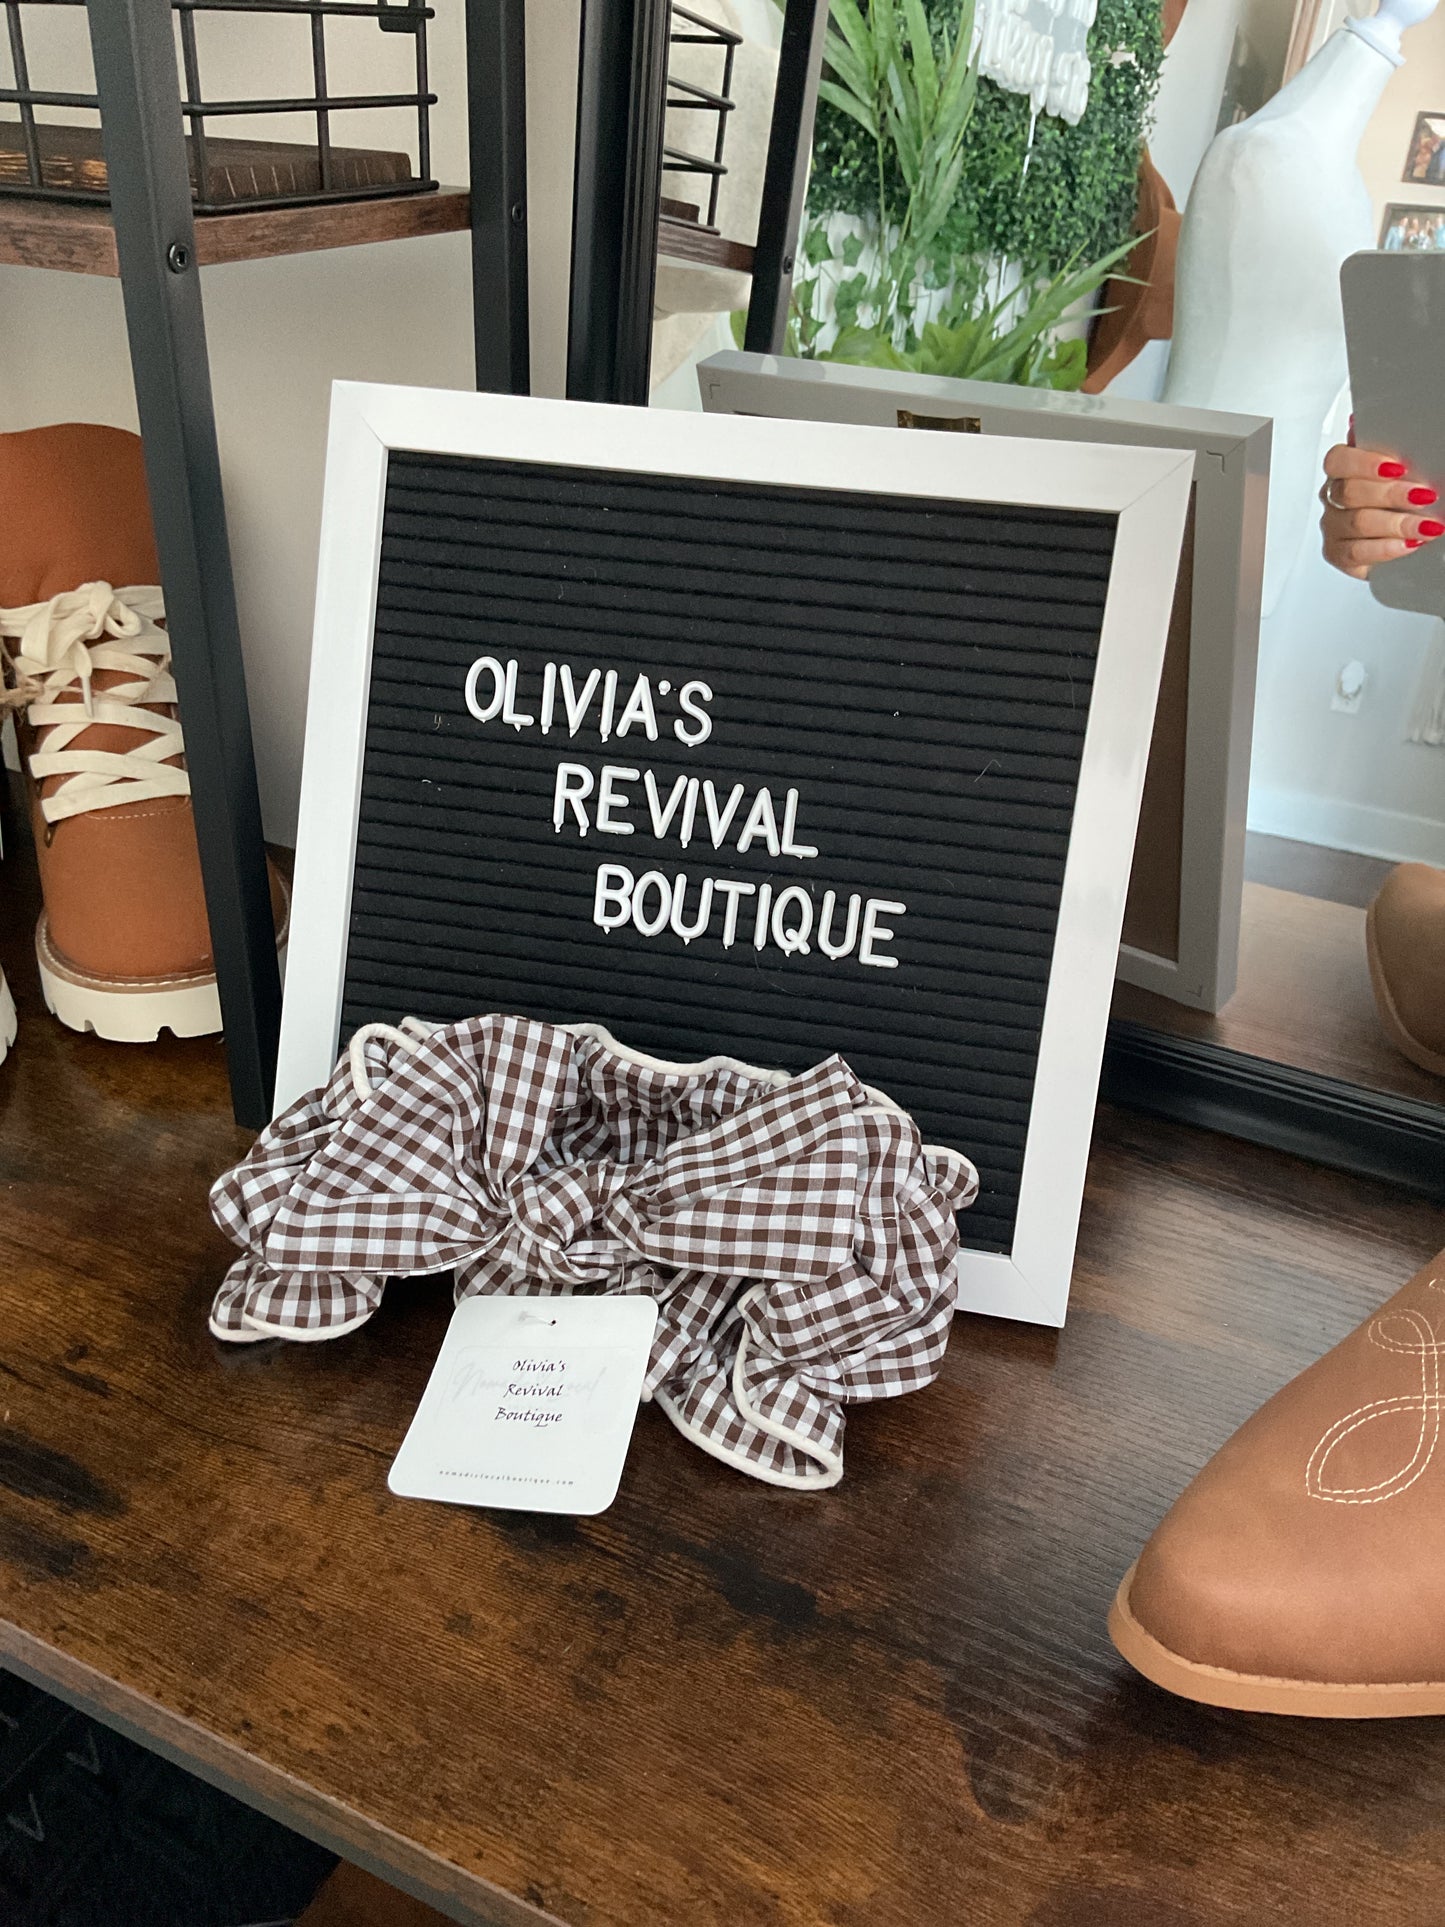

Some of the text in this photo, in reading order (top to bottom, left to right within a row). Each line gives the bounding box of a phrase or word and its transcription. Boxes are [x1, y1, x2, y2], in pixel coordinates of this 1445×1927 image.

[464, 656, 713, 747] OLIVIA'S
[552, 762, 819, 858] REVIVAL
[593, 863, 907, 968] BOUTIQUE
[503, 1383, 562, 1398] Revival
[512, 1359, 566, 1372] Olivia's
[494, 1407, 563, 1428] Boutique
